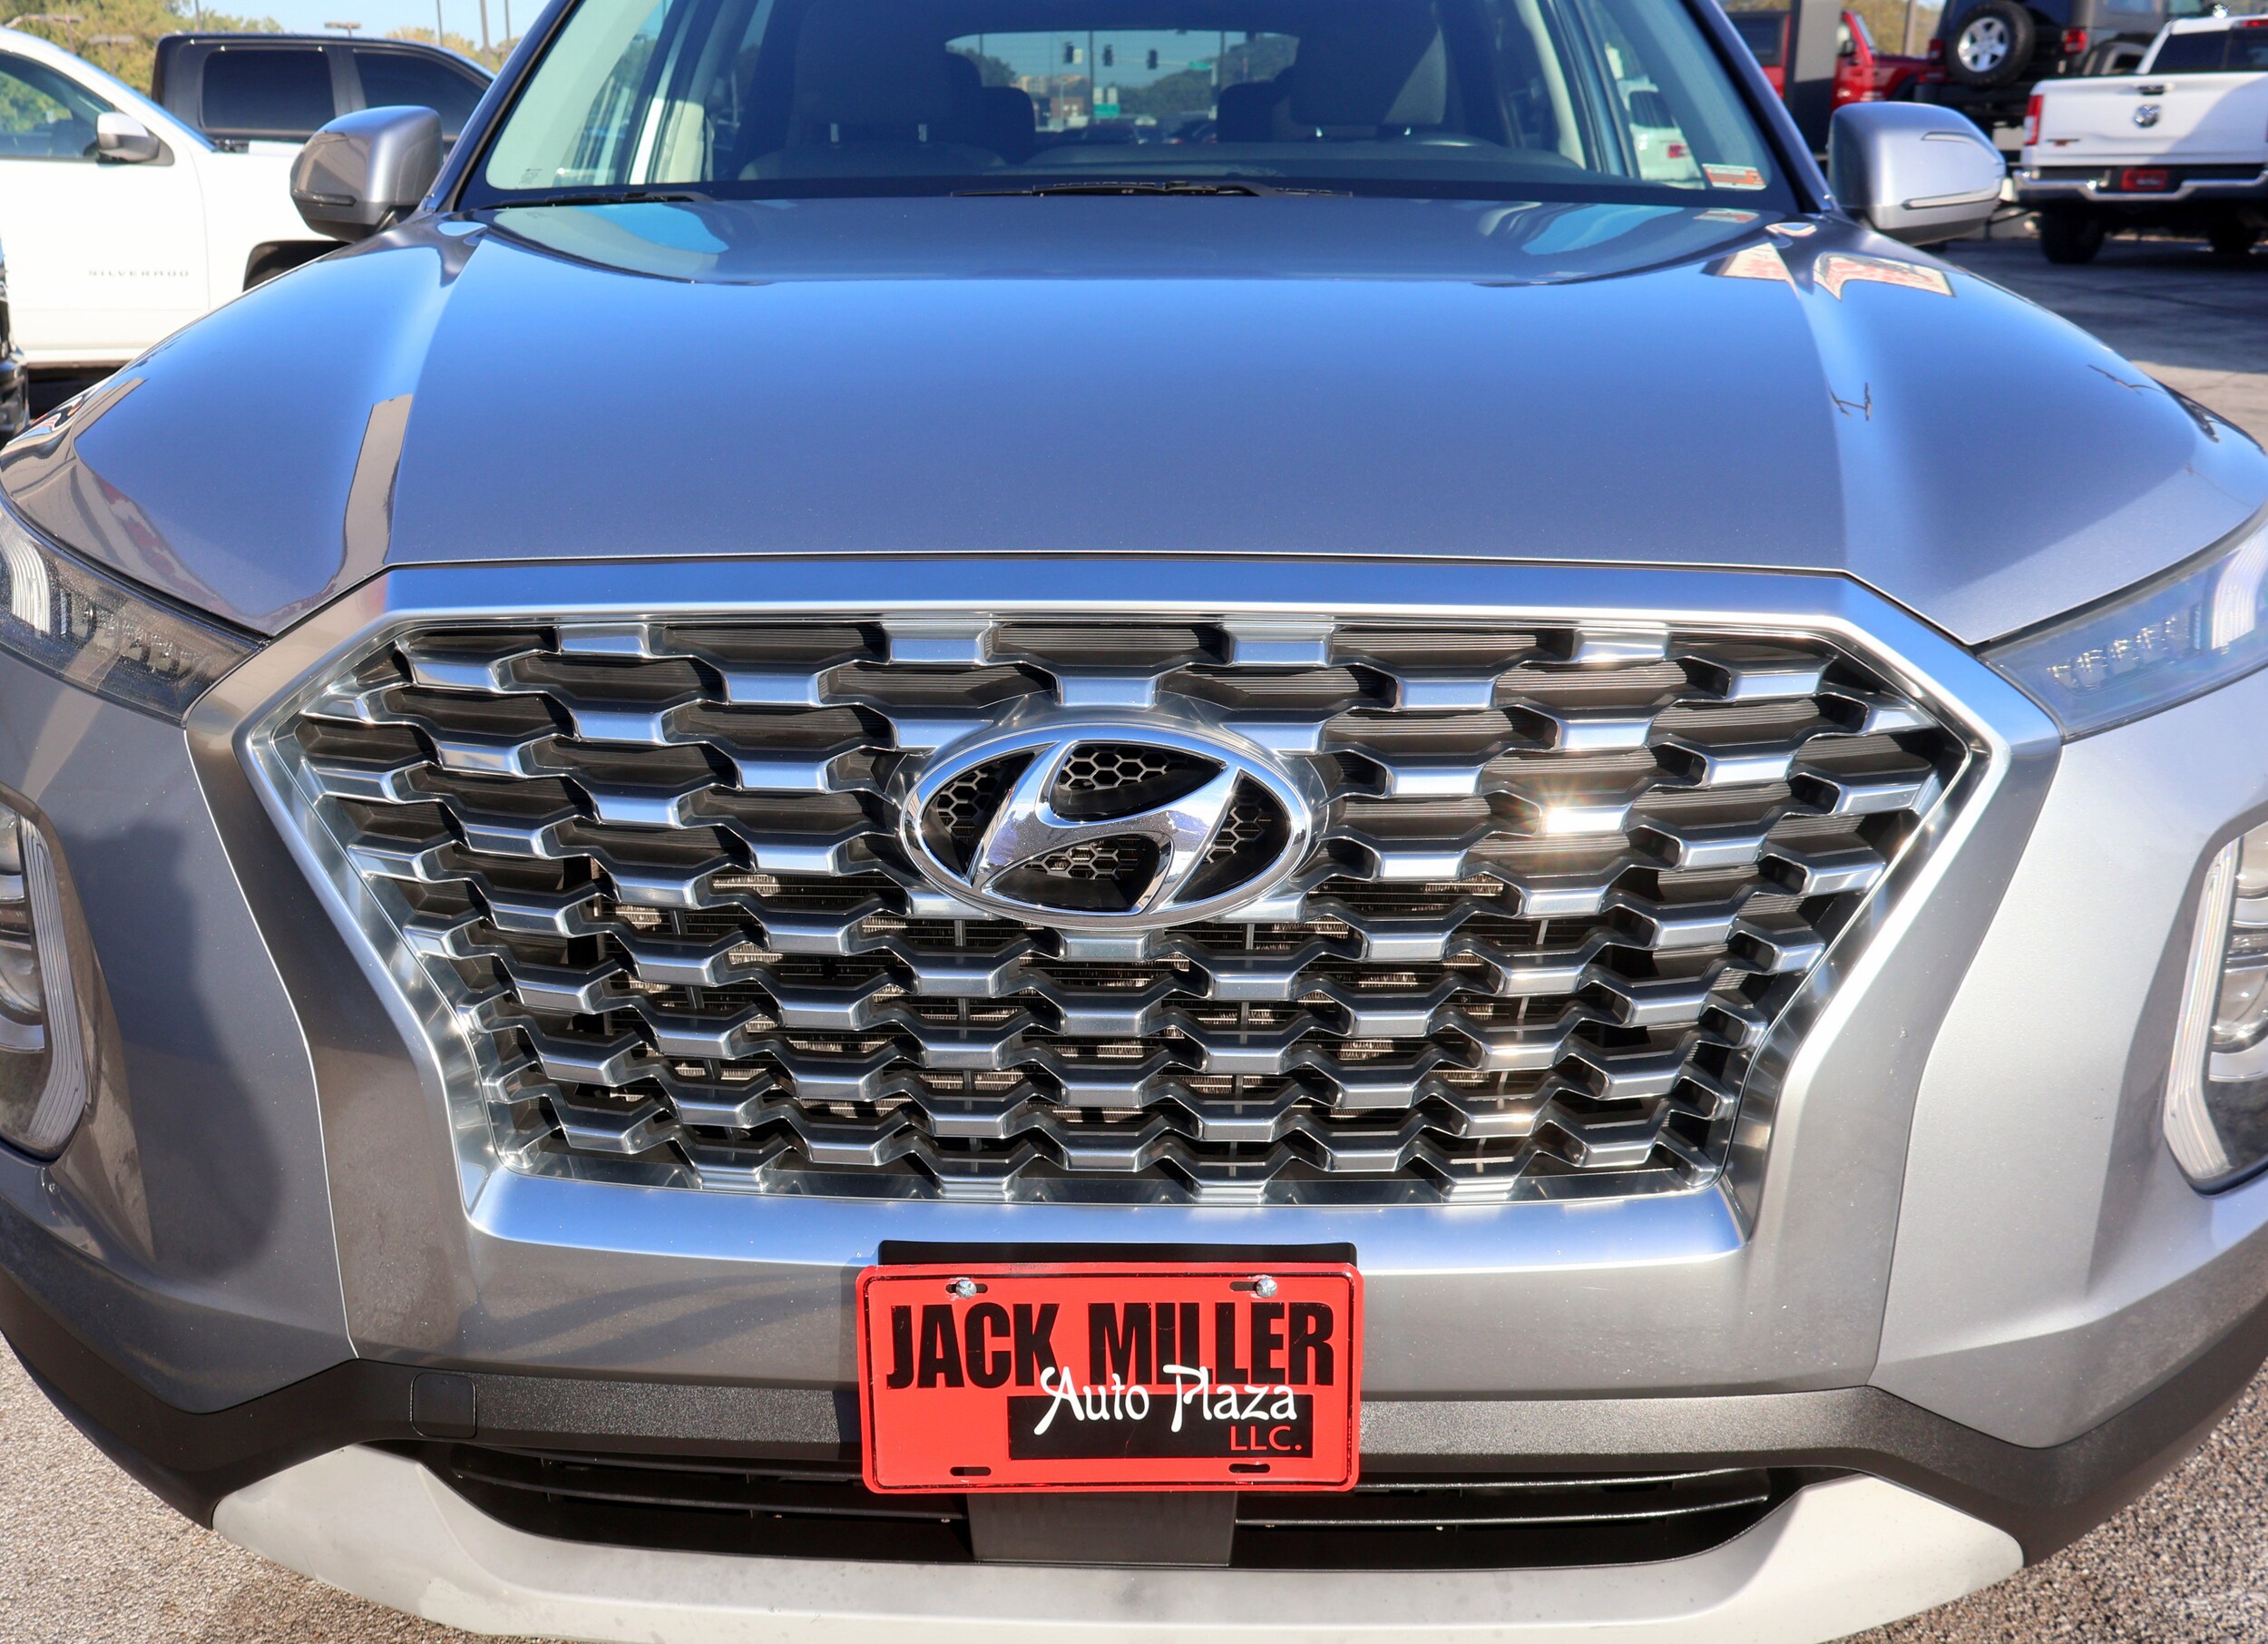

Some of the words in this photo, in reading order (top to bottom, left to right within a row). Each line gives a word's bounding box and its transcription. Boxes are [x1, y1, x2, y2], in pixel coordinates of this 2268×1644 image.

[886, 1303, 1060, 1389] JACK
[1088, 1302, 1334, 1385] MILLER
[1034, 1365, 1149, 1435] Auto
[1163, 1365, 1297, 1433] Plaza
[1230, 1425, 1302, 1451] LLC.
